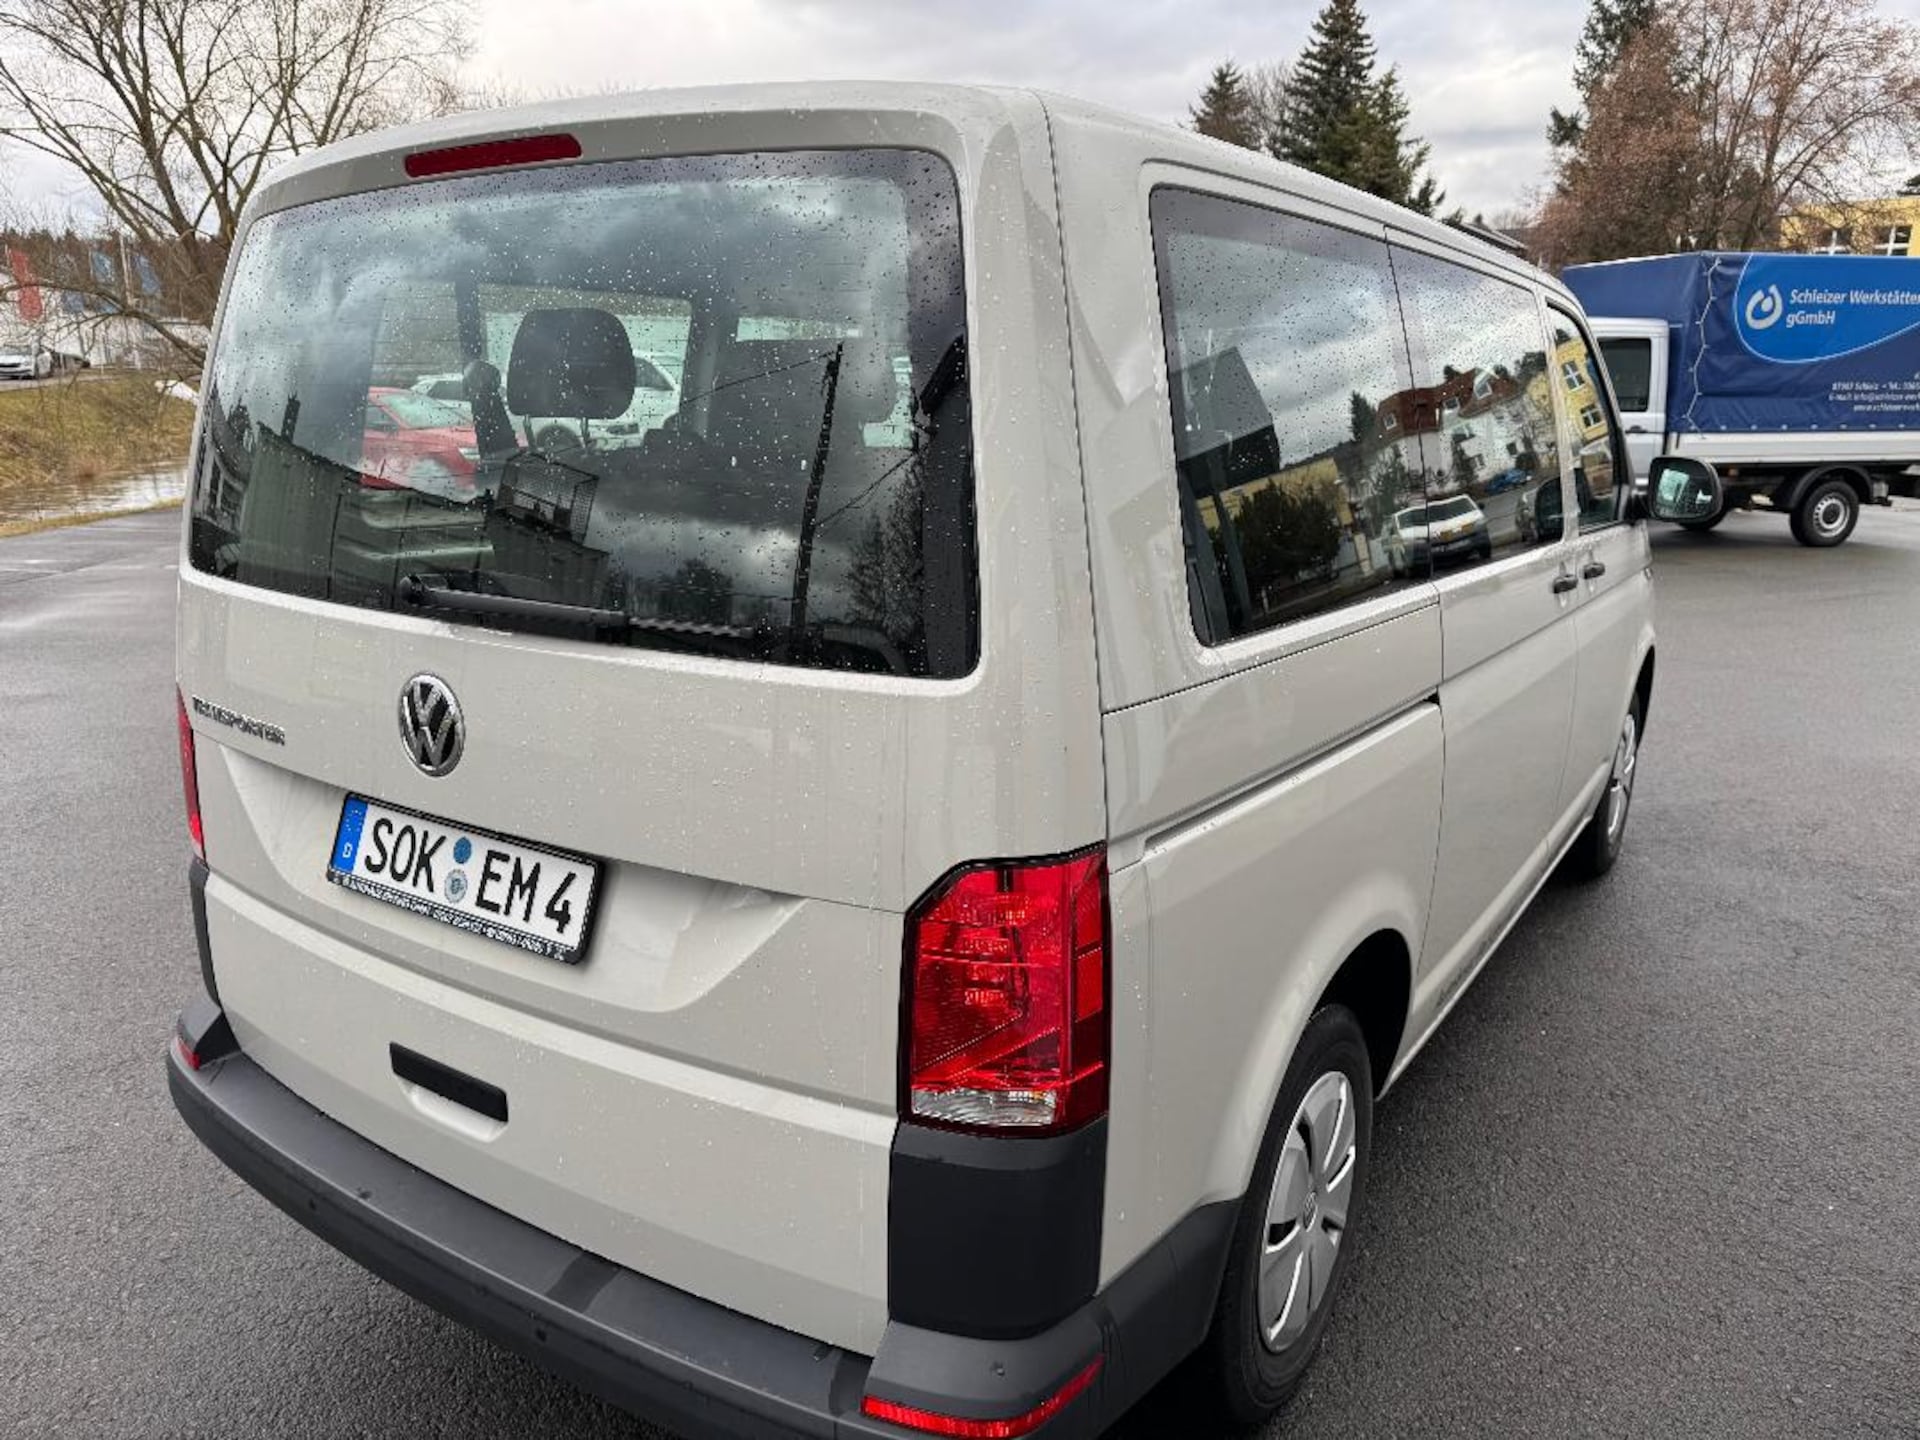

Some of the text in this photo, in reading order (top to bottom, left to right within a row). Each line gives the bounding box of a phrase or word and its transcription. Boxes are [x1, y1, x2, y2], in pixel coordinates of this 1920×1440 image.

[1789, 288, 1848, 305] Schleizer
[1786, 310, 1836, 328] gGmbH
[192, 694, 286, 746] TRANSPORTER
[364, 817, 448, 893] SOK
[475, 848, 542, 923] EM
[545, 871, 577, 935] 4
